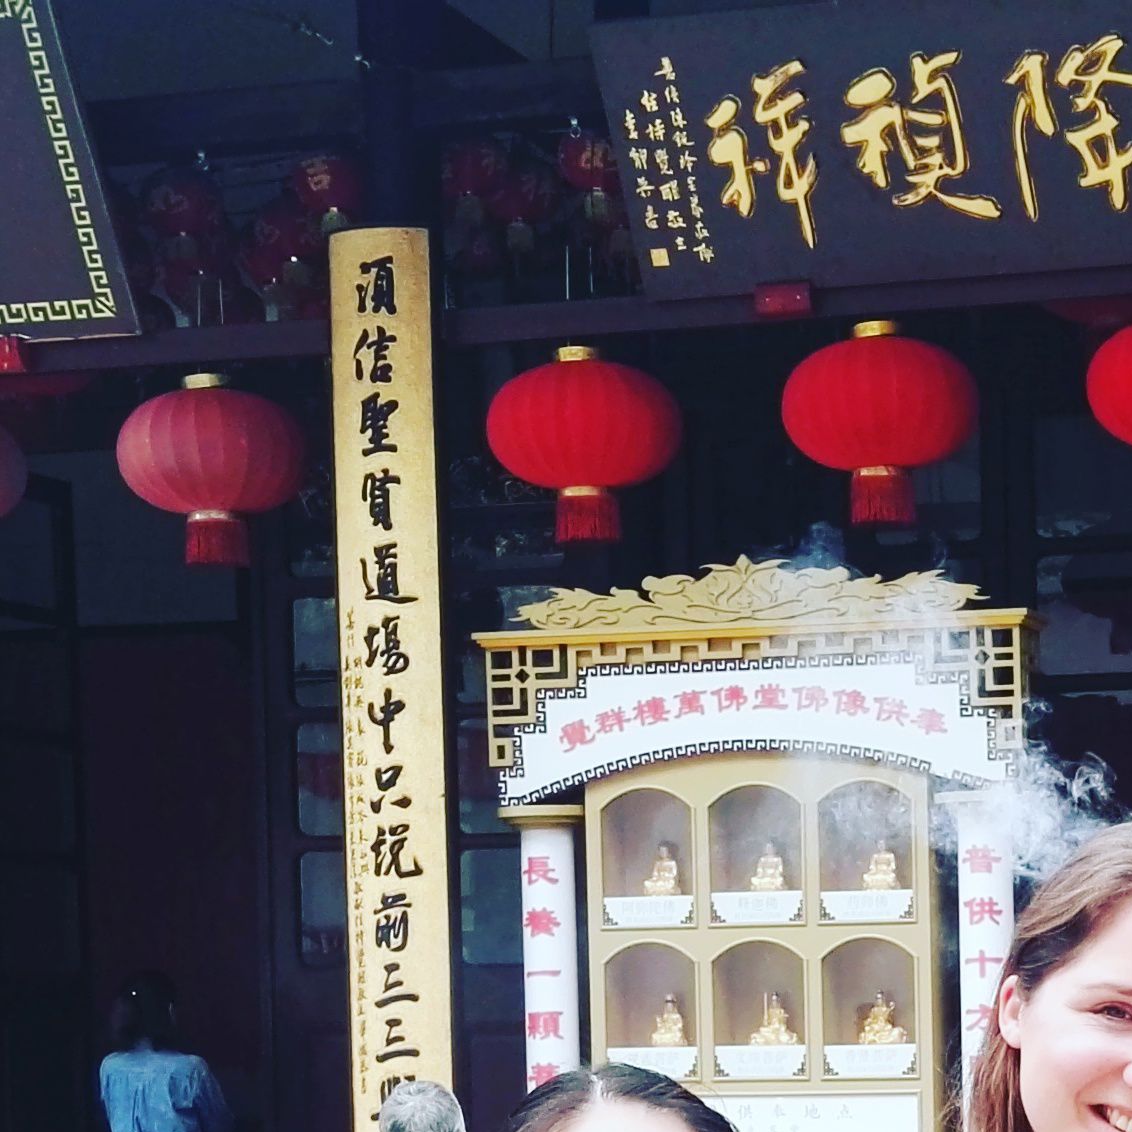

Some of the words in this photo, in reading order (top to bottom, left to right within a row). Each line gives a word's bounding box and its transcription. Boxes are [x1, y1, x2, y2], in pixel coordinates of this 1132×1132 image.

[558, 683, 950, 754] 覺群樓萬佛堂佛像供奉
[963, 845, 1004, 1078] 普供十方
